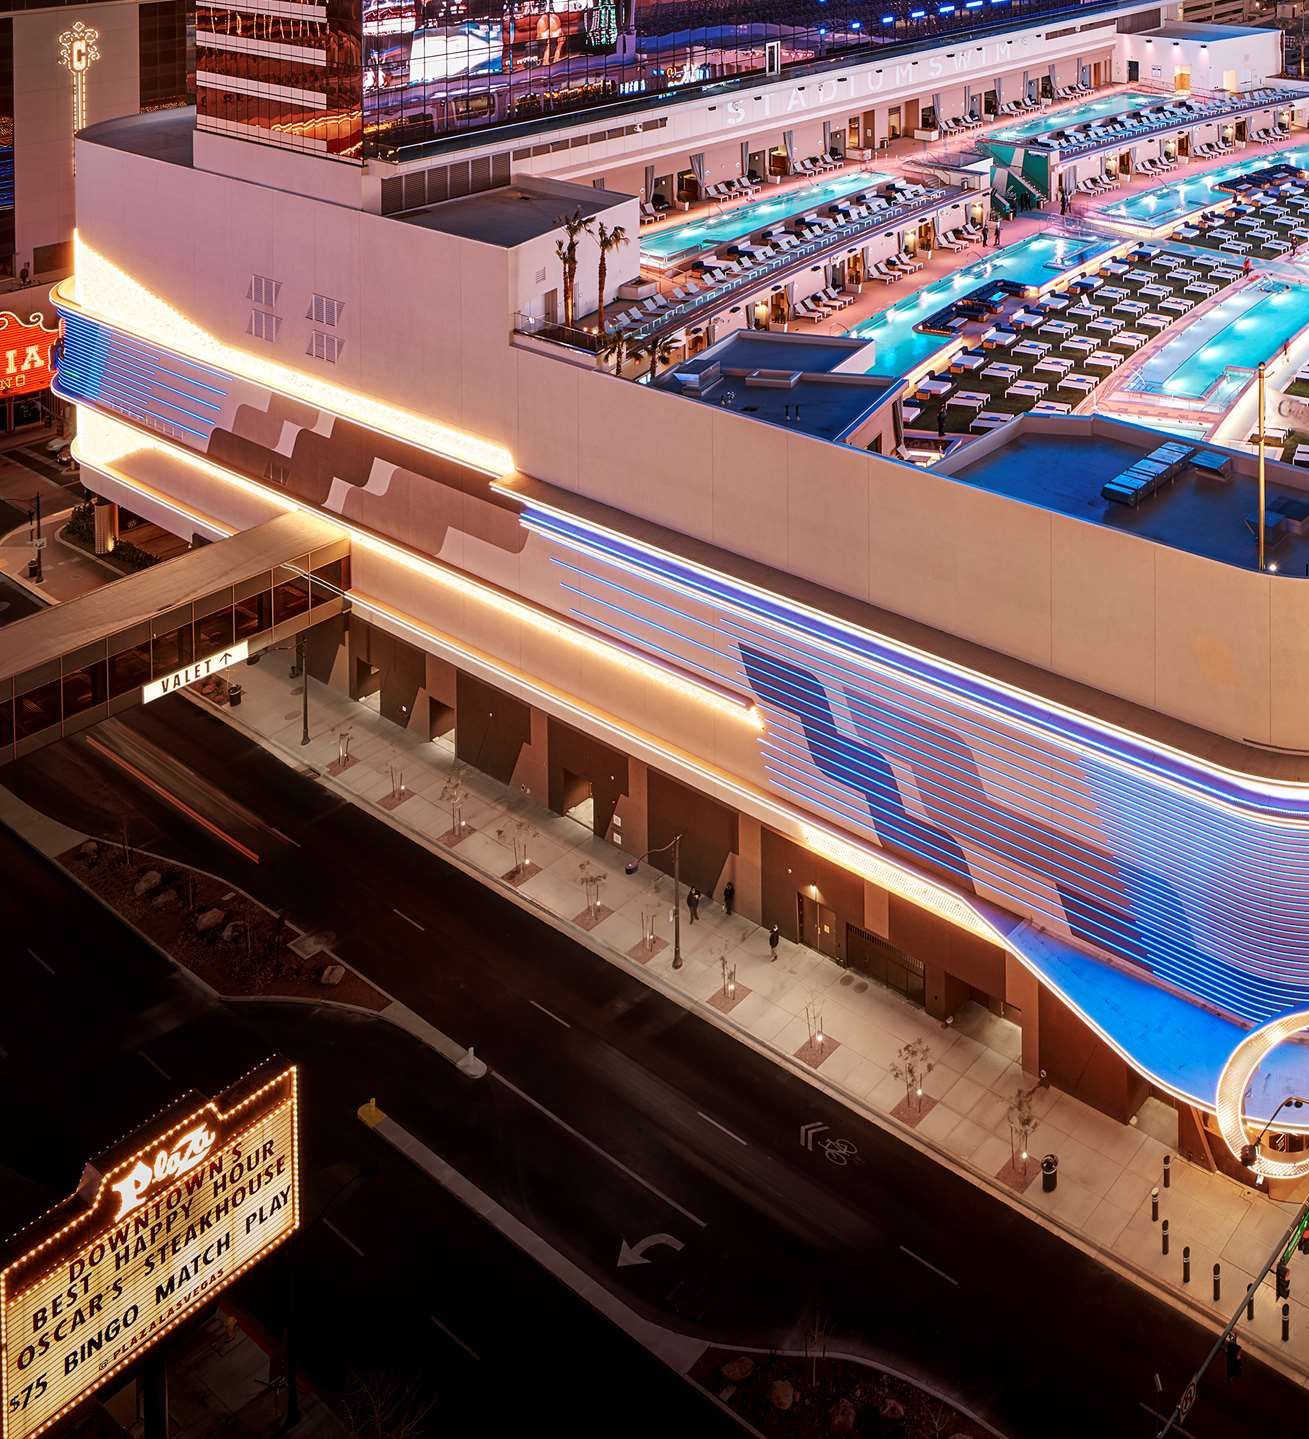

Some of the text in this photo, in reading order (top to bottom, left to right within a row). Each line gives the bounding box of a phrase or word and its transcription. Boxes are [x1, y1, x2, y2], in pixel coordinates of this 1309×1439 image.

[73, 40, 86, 70] C
[727, 42, 1010, 125] STADIUM SWIM
[161, 659, 212, 694] VALET
[67, 1141, 243, 1285] DOWNTOWN'S
[111, 1123, 216, 1223] Plaza
[16, 1154, 287, 1371] OSCAR'S STEAKHOUSE
[32, 1139, 276, 1334] BEST HAPPY HOUR
[8, 1184, 292, 1415] $75 BINGO MATCH PLAY
